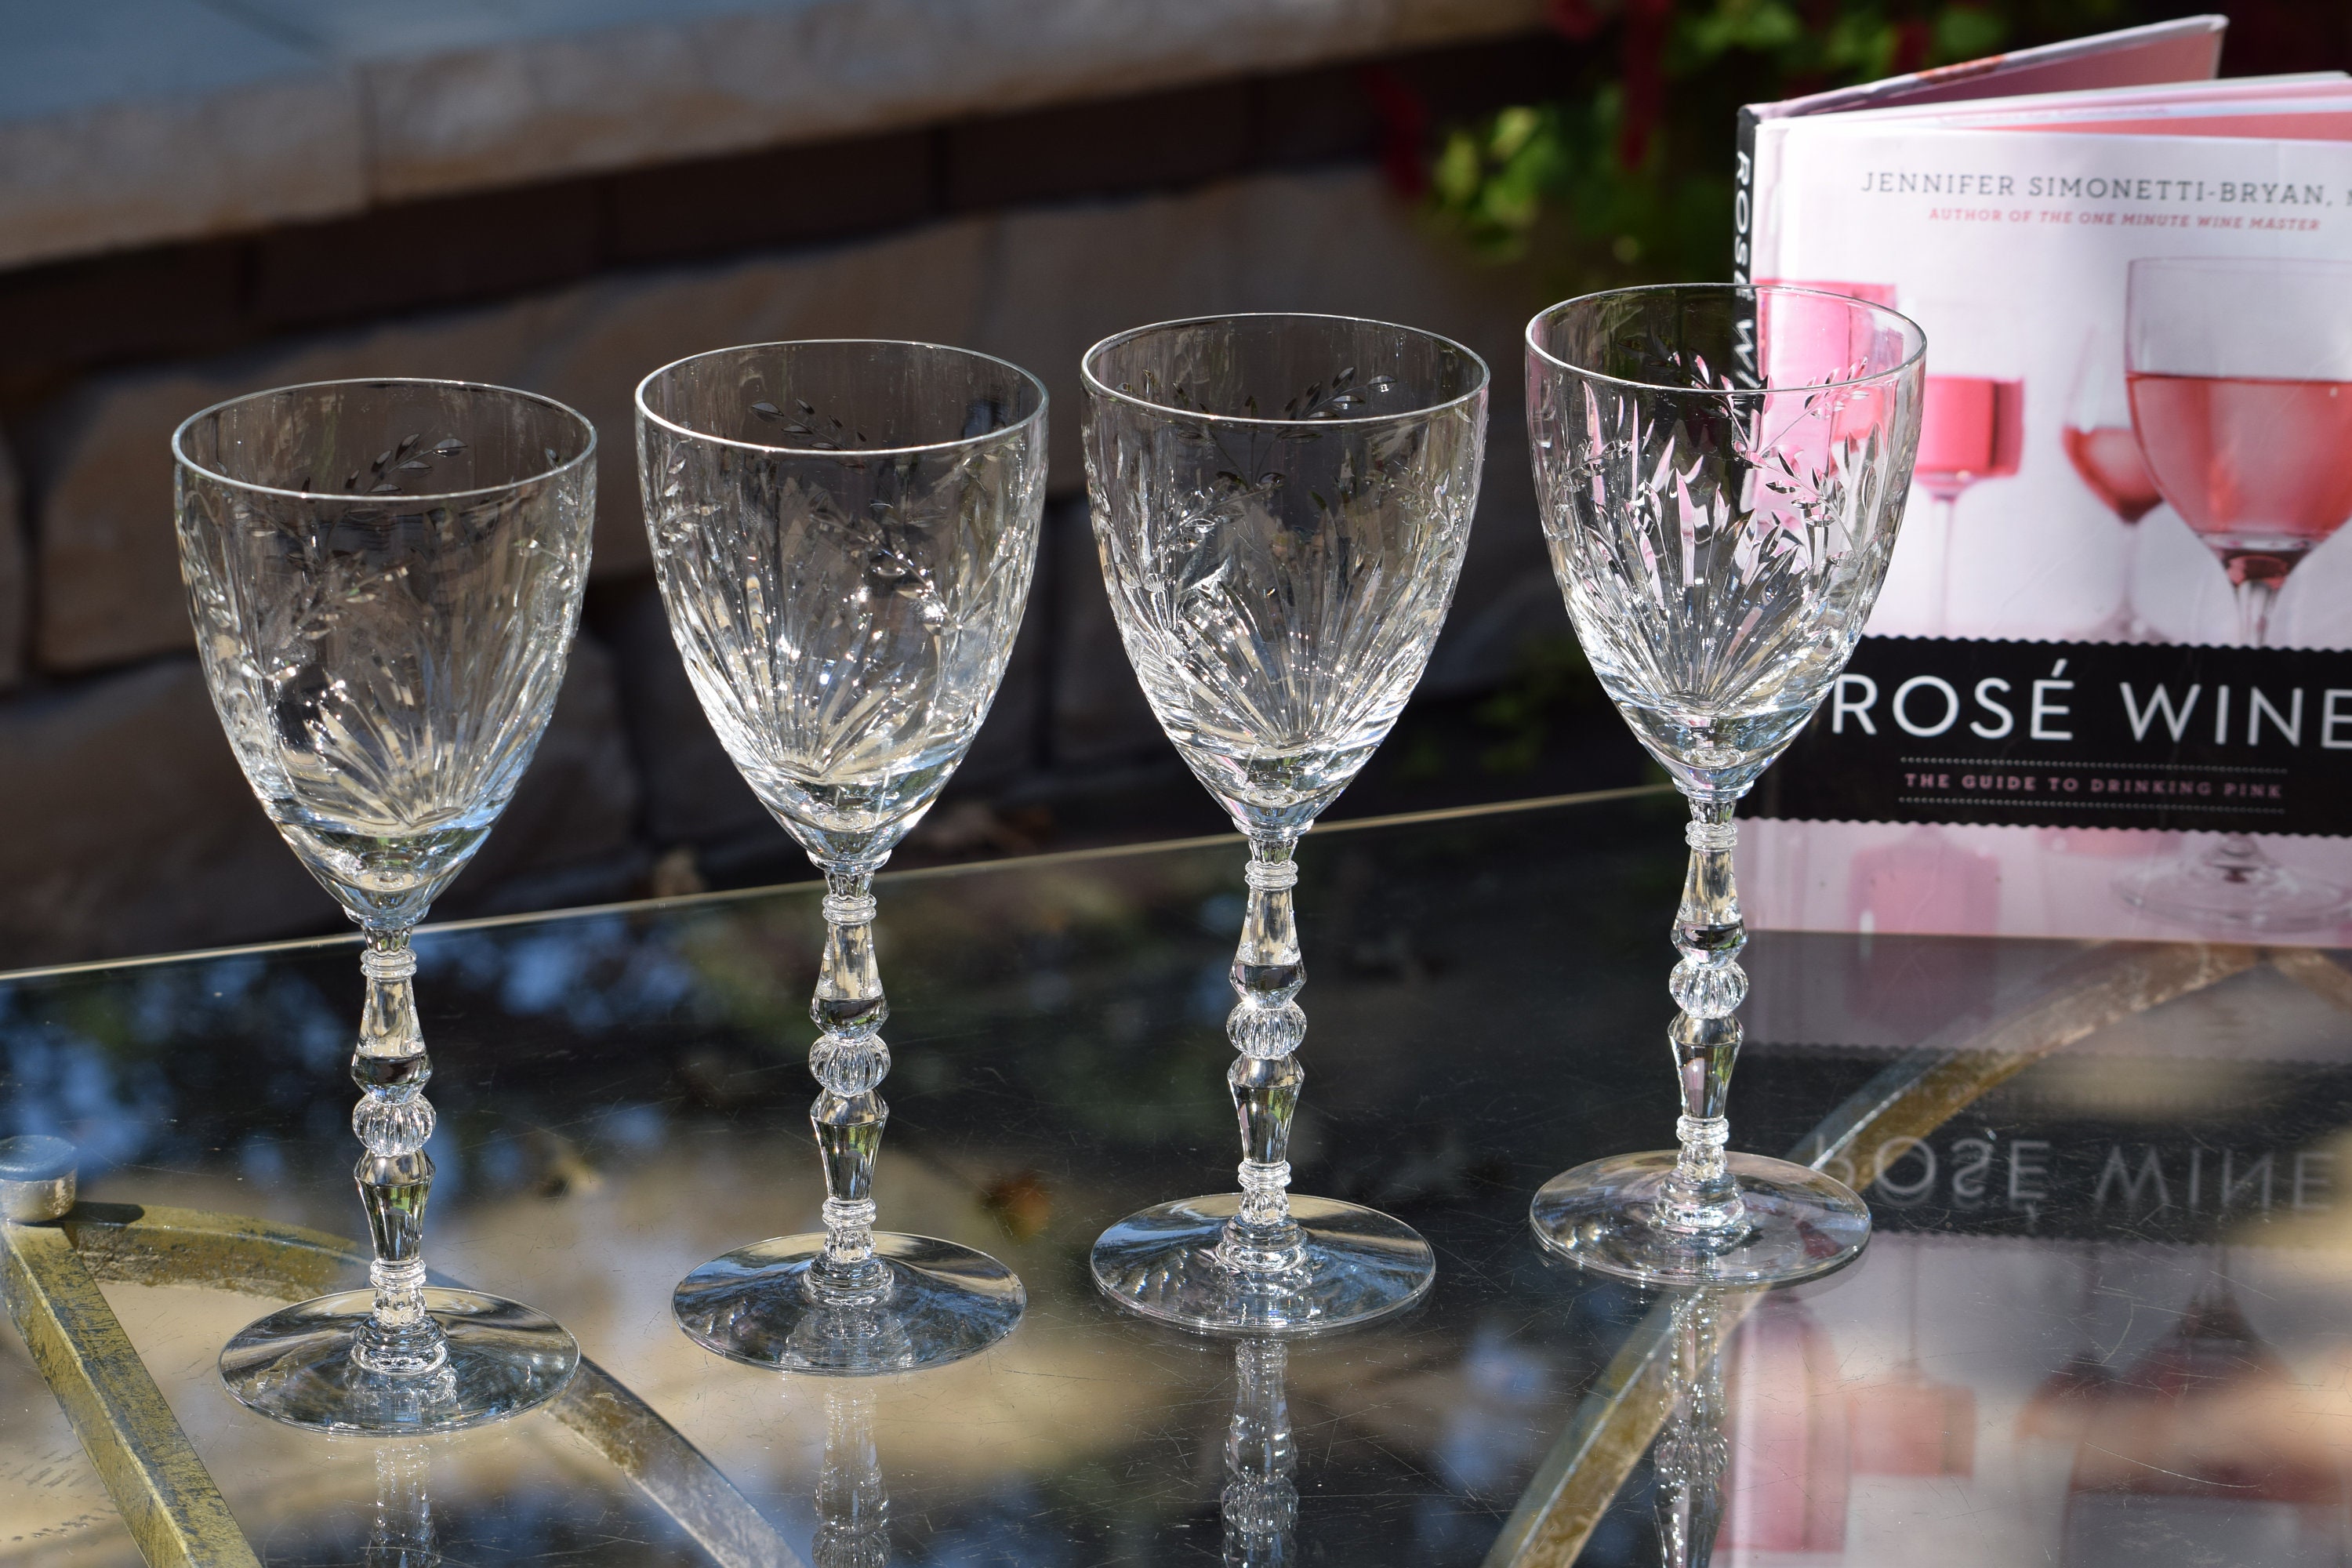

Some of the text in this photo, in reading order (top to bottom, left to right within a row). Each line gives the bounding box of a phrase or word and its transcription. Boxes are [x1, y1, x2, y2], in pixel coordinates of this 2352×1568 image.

[1860, 171, 2016, 197] JENNIFER
[2027, 176, 2333, 208] SIMONETTI-BRYAN,
[1929, 207, 2321, 232] AUTHOR OF THE ONE MINUTE WINE MASTER
[1831, 657, 2352, 749] ROSÉ WINE
[1904, 772, 2283, 799] THE GUIDE TO DRINKING PINK
